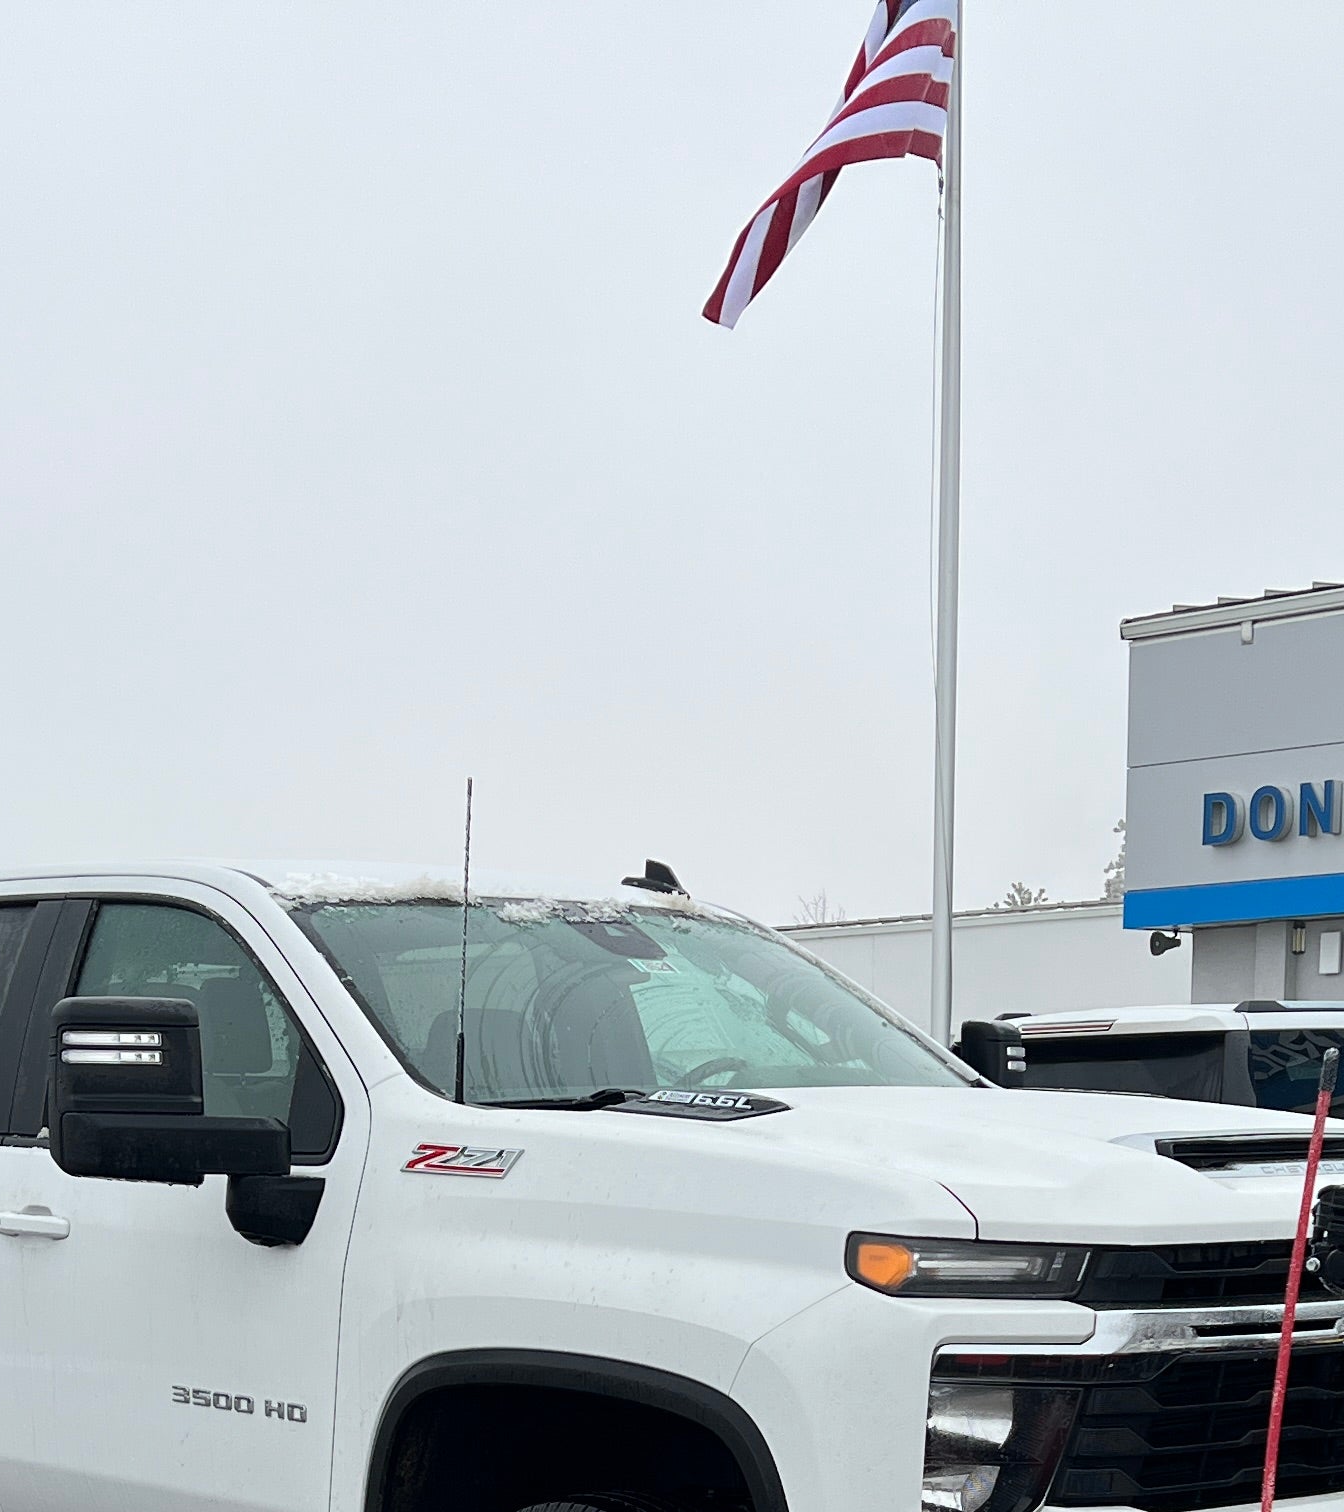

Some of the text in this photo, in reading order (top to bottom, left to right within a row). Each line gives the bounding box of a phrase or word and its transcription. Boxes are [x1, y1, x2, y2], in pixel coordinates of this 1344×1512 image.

[400, 1141, 525, 1179] Z71
[171, 1385, 308, 1423] 3500 HD
